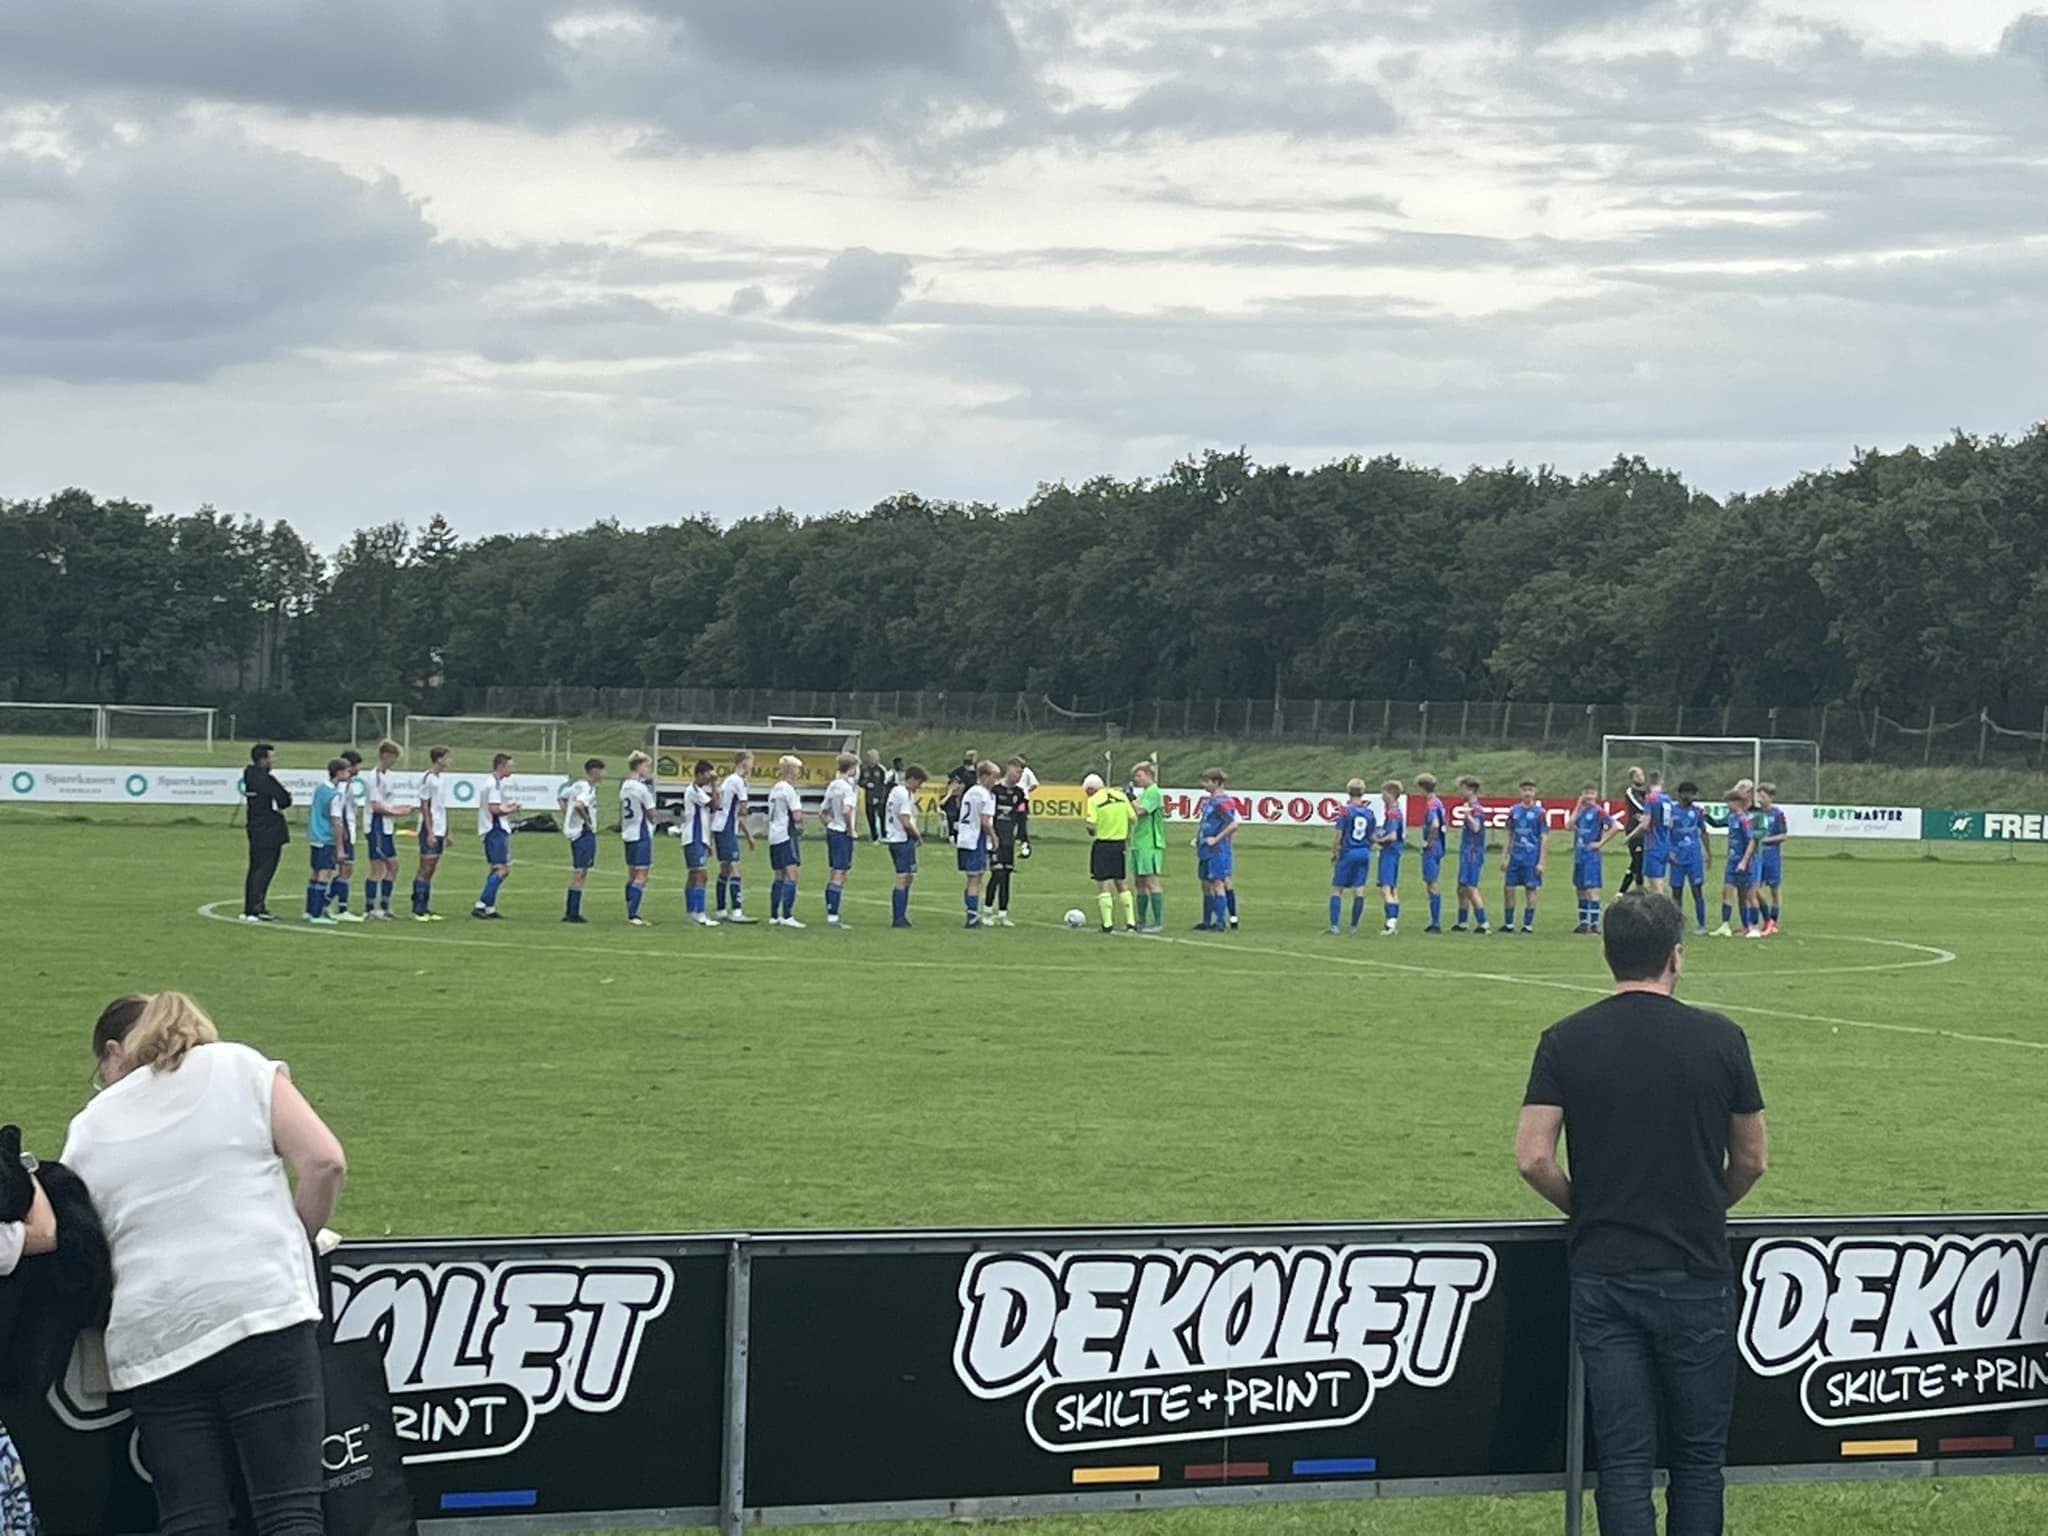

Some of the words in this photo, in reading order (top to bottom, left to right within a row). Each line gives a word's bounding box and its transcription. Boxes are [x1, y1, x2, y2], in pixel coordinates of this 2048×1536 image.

[960, 801, 970, 824] 2
[1812, 808, 1903, 822] SPORTMASTER
[1352, 816, 1368, 841] 8
[955, 1246, 1495, 1397] DEKOLET
